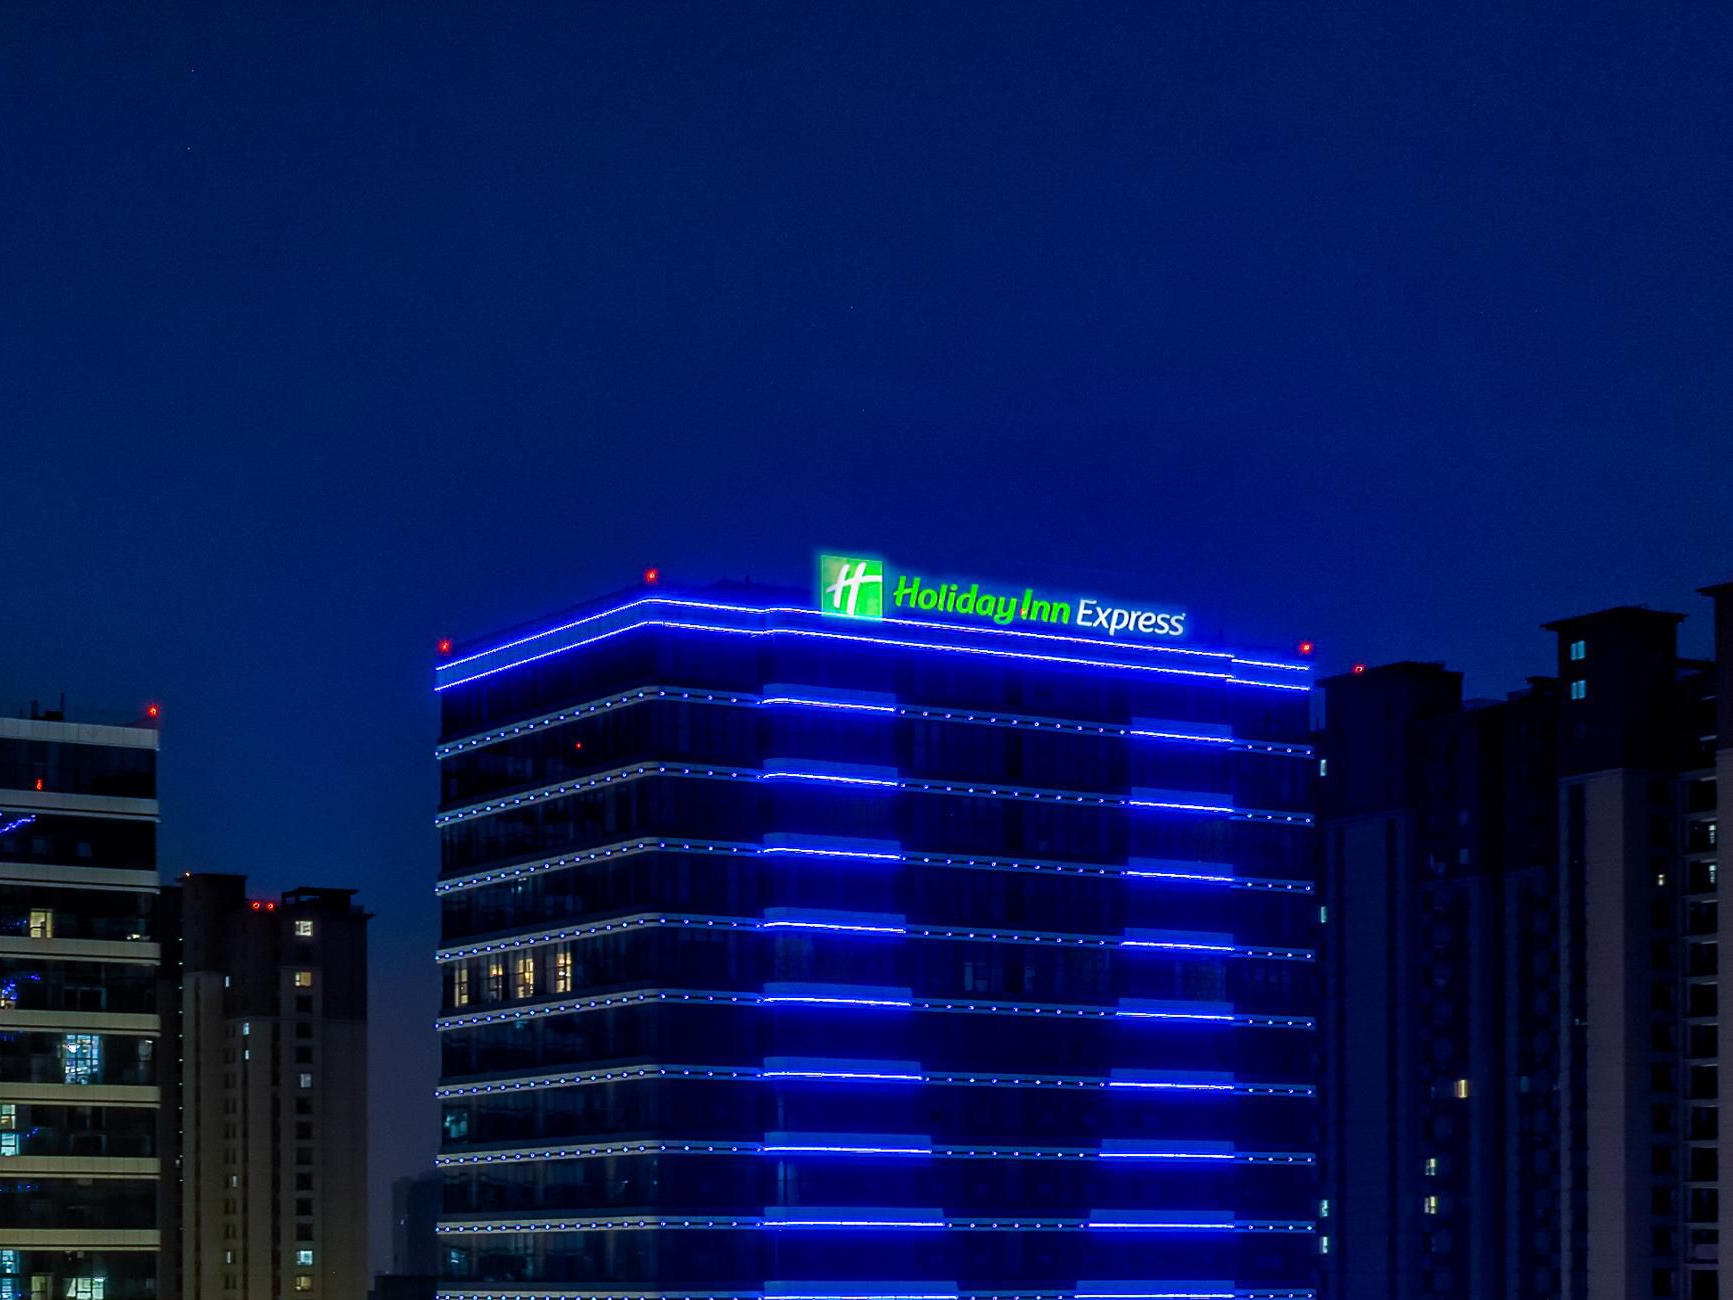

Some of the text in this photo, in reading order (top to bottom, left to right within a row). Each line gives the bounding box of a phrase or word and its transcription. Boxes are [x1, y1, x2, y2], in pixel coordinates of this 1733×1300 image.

[893, 575, 1016, 625] Holiday
[1023, 588, 1070, 624] Inn
[1077, 599, 1184, 636] Express
